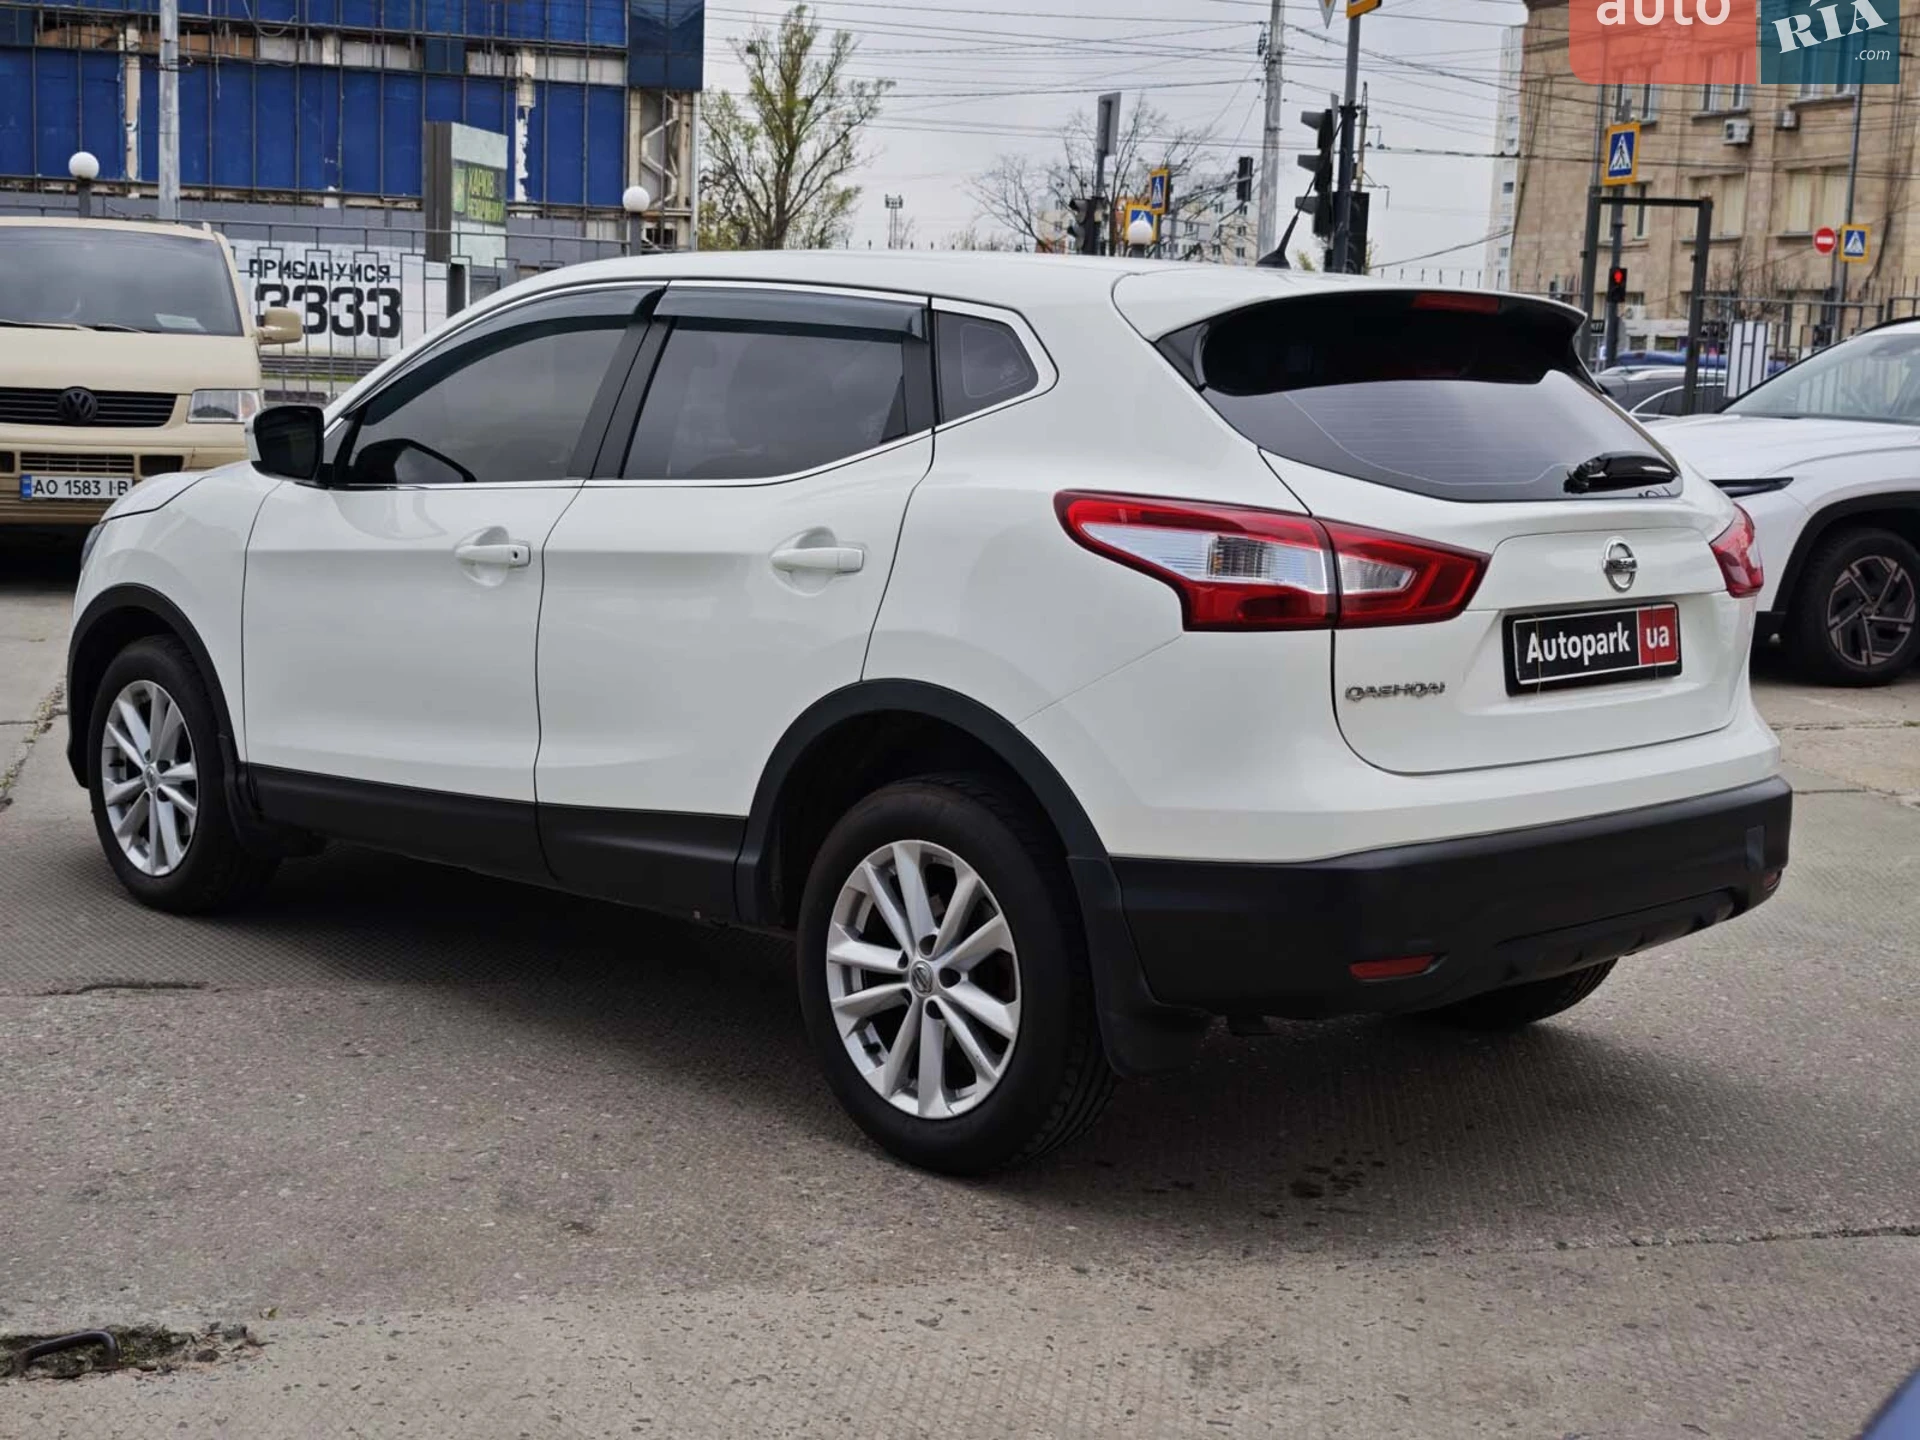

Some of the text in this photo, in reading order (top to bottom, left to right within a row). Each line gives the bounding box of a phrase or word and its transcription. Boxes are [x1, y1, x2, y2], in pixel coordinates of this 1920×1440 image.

[33, 479, 58, 495] AO
[64, 480, 101, 495] 1583
[1526, 621, 1669, 666] Autopark ua
